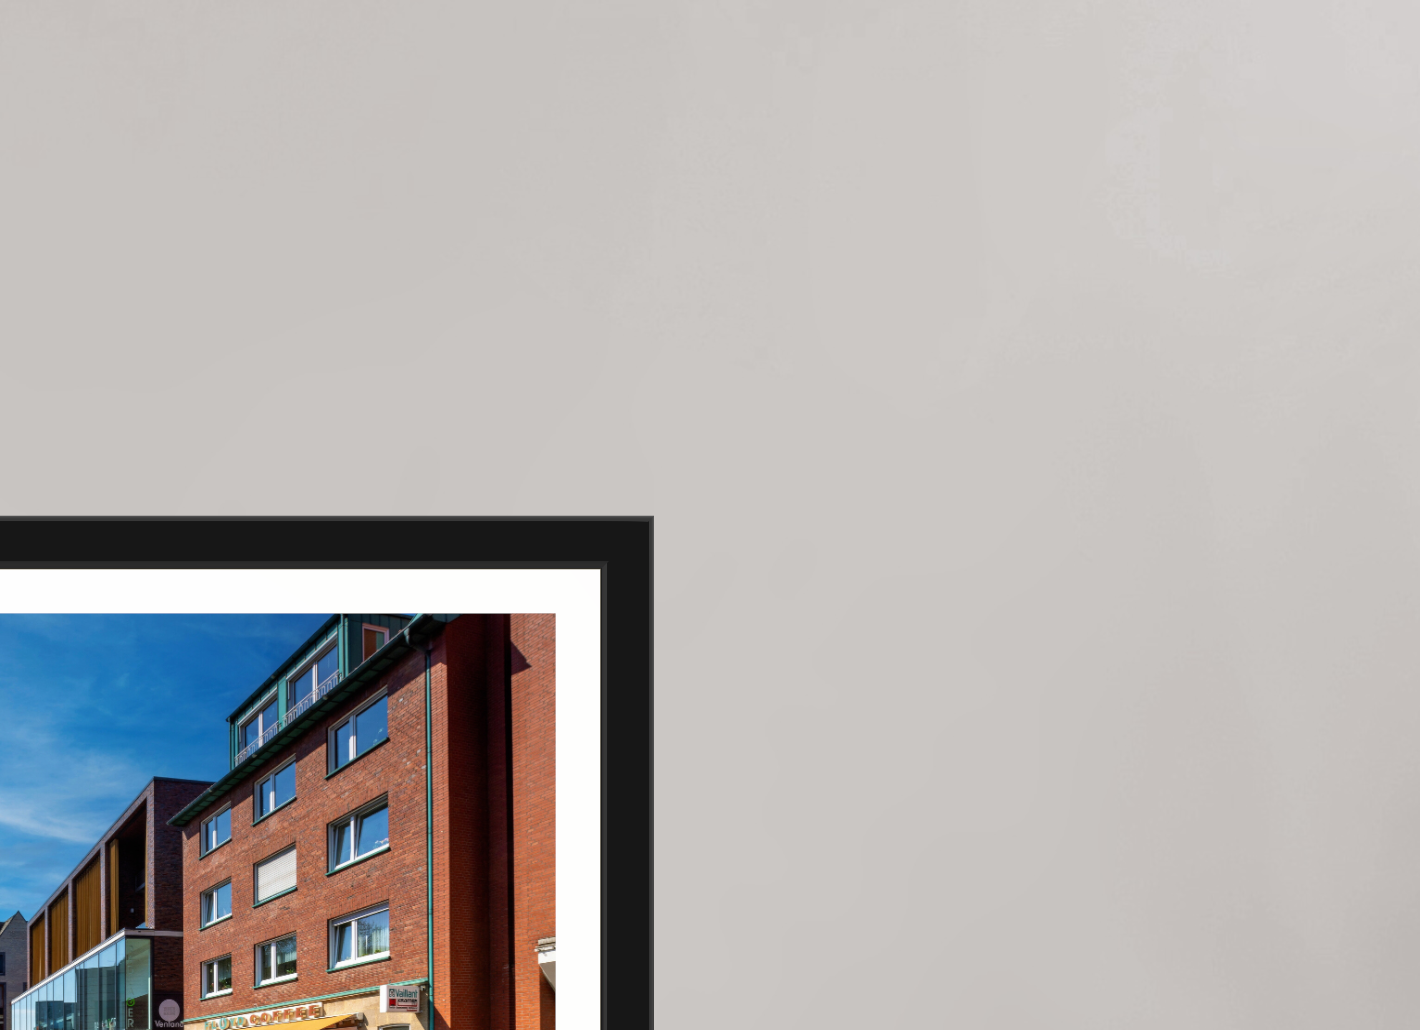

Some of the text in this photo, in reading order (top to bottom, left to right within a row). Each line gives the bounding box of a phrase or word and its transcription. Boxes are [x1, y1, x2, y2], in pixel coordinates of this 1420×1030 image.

[395, 988, 418, 999] Vaillant
[203, 1004, 322, 1030] FLOYD COFFEE
